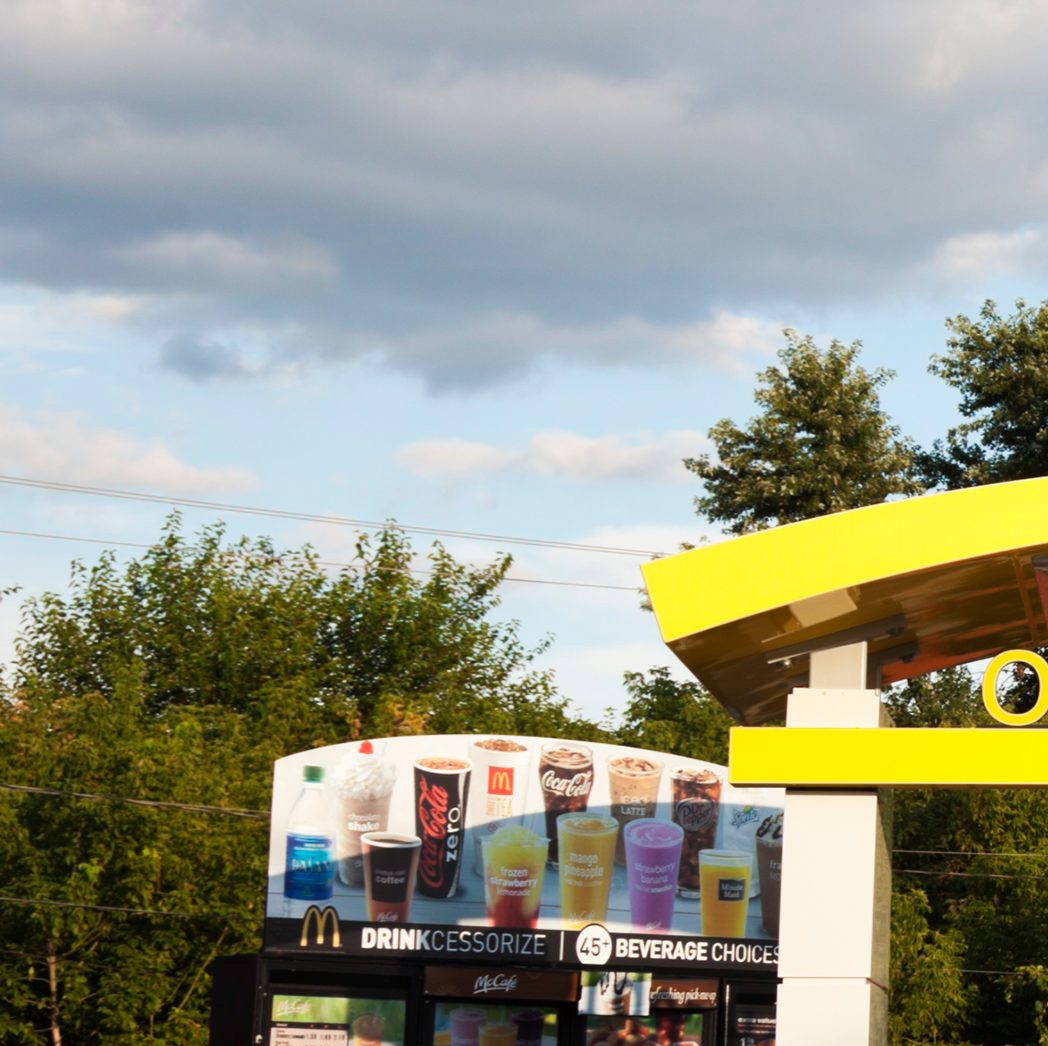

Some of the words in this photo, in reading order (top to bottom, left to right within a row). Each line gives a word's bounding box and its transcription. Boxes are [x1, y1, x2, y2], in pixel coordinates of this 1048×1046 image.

[620, 806, 646, 816] LATTE
[361, 928, 546, 956] DRINKCESSORIZE
[616, 938, 708, 962] BEVERAGE
[712, 942, 779, 965] CHOICES
